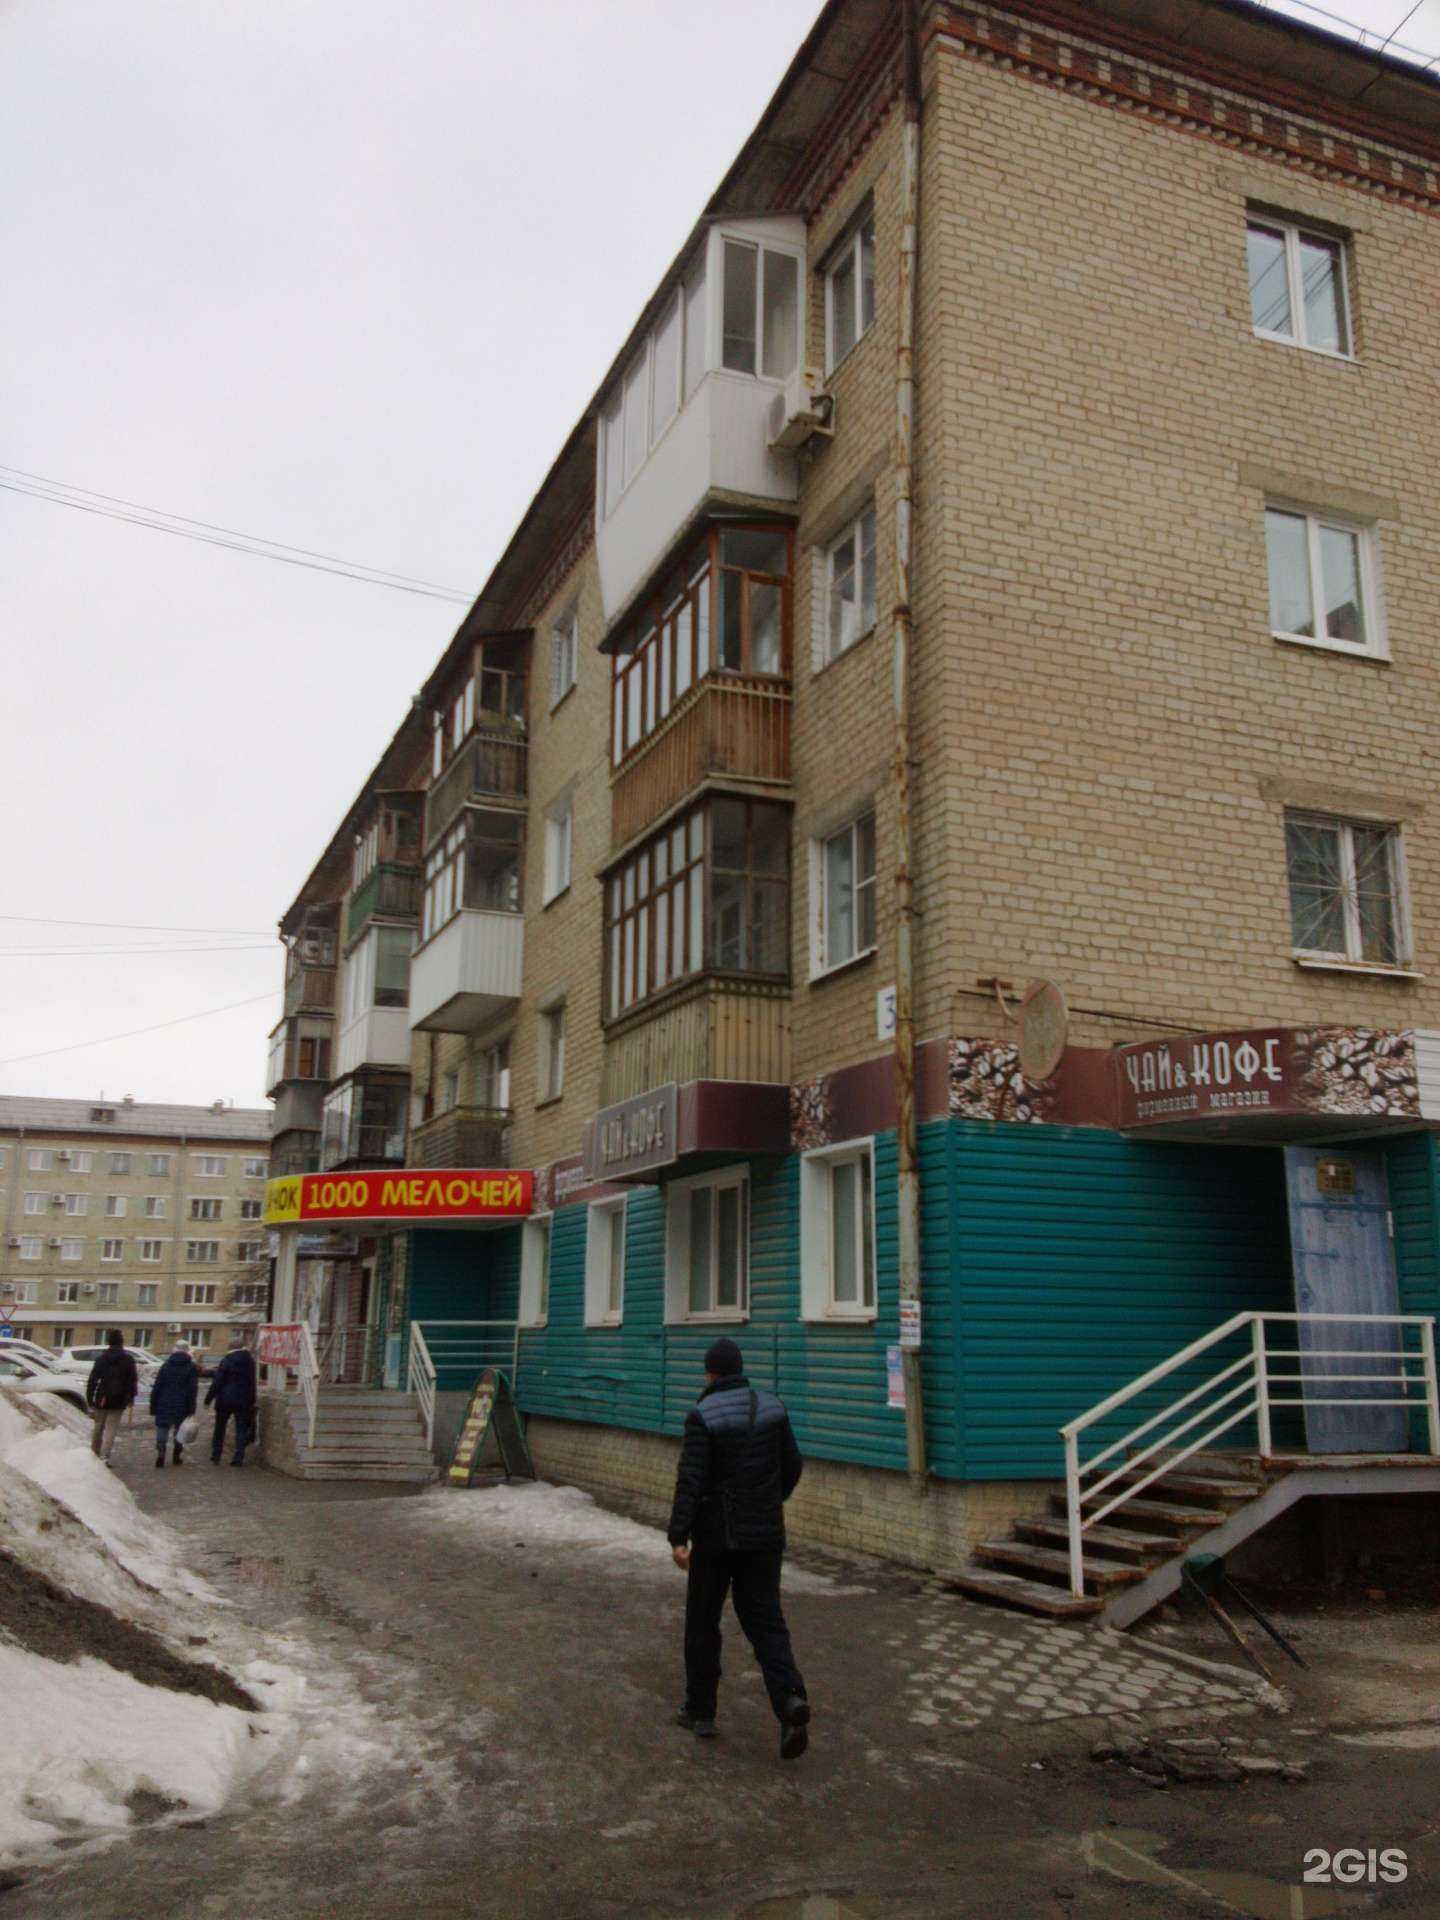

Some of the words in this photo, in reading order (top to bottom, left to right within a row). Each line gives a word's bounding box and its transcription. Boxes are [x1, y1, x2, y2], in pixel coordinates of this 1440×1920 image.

[1209, 1090, 1270, 1109] магазин
[308, 1180, 368, 1209] 1000
[381, 1174, 522, 1207] МЕЛОЧЕЙ
